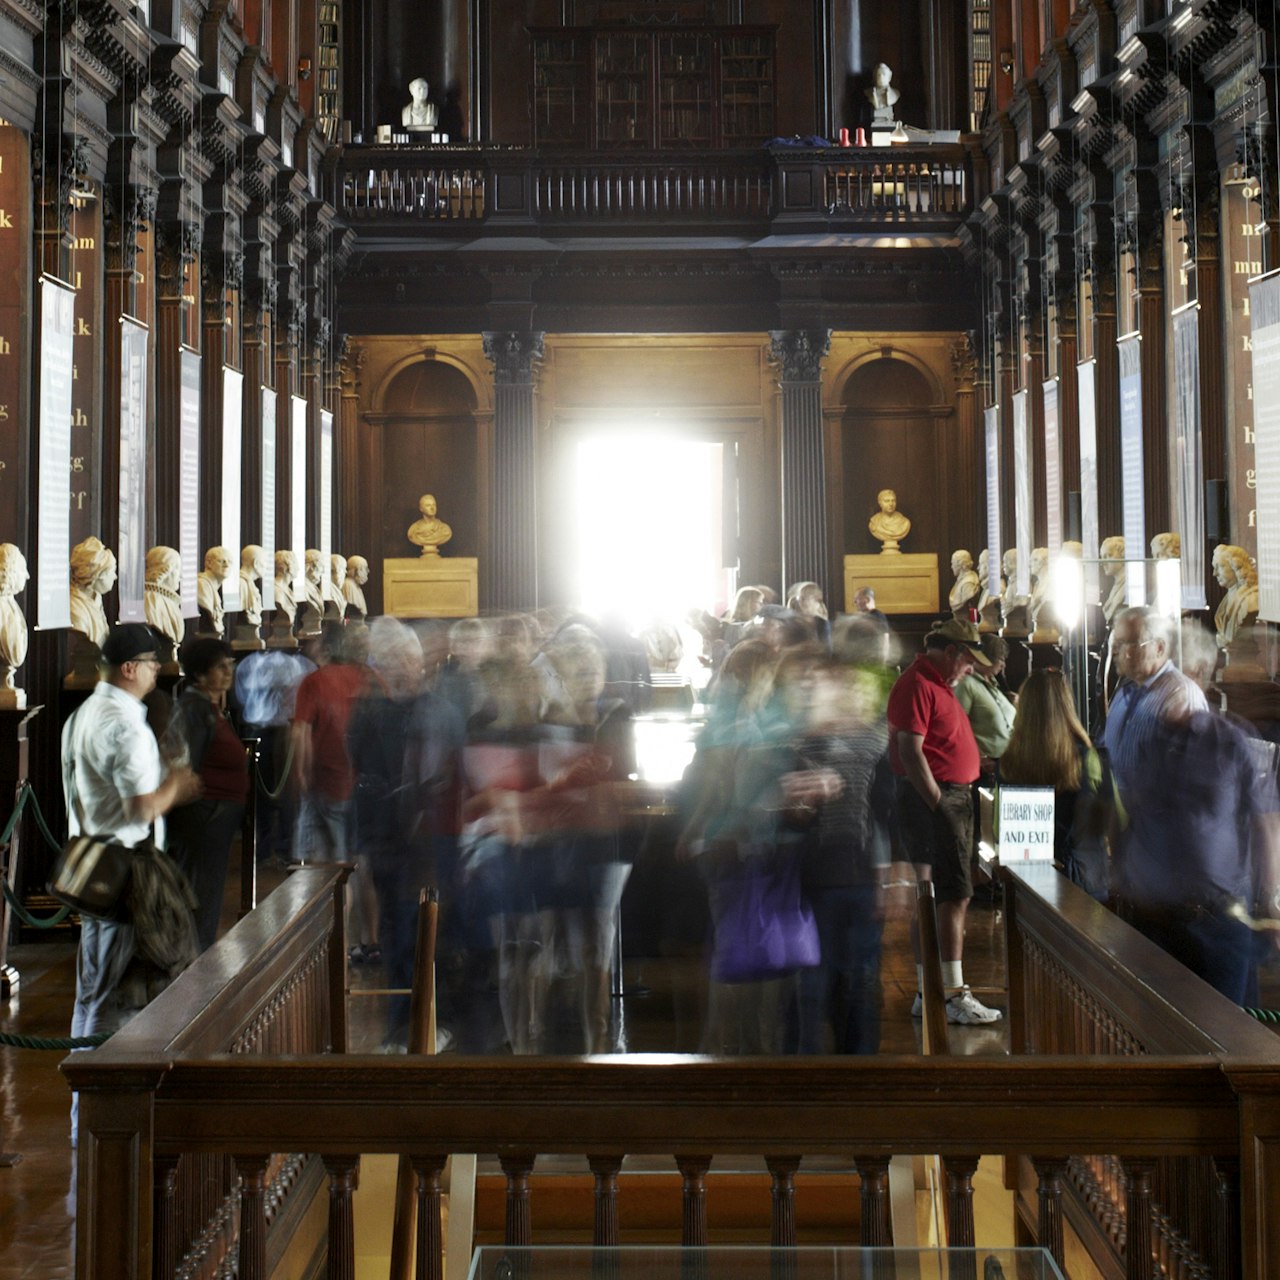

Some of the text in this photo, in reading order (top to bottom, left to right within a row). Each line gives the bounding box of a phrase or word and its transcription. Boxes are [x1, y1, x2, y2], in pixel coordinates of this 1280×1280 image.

[73, 318, 93, 336] k
[1002, 803, 1053, 822] LIBRARY SHOP
[1004, 831, 1050, 844] AND EXIT
